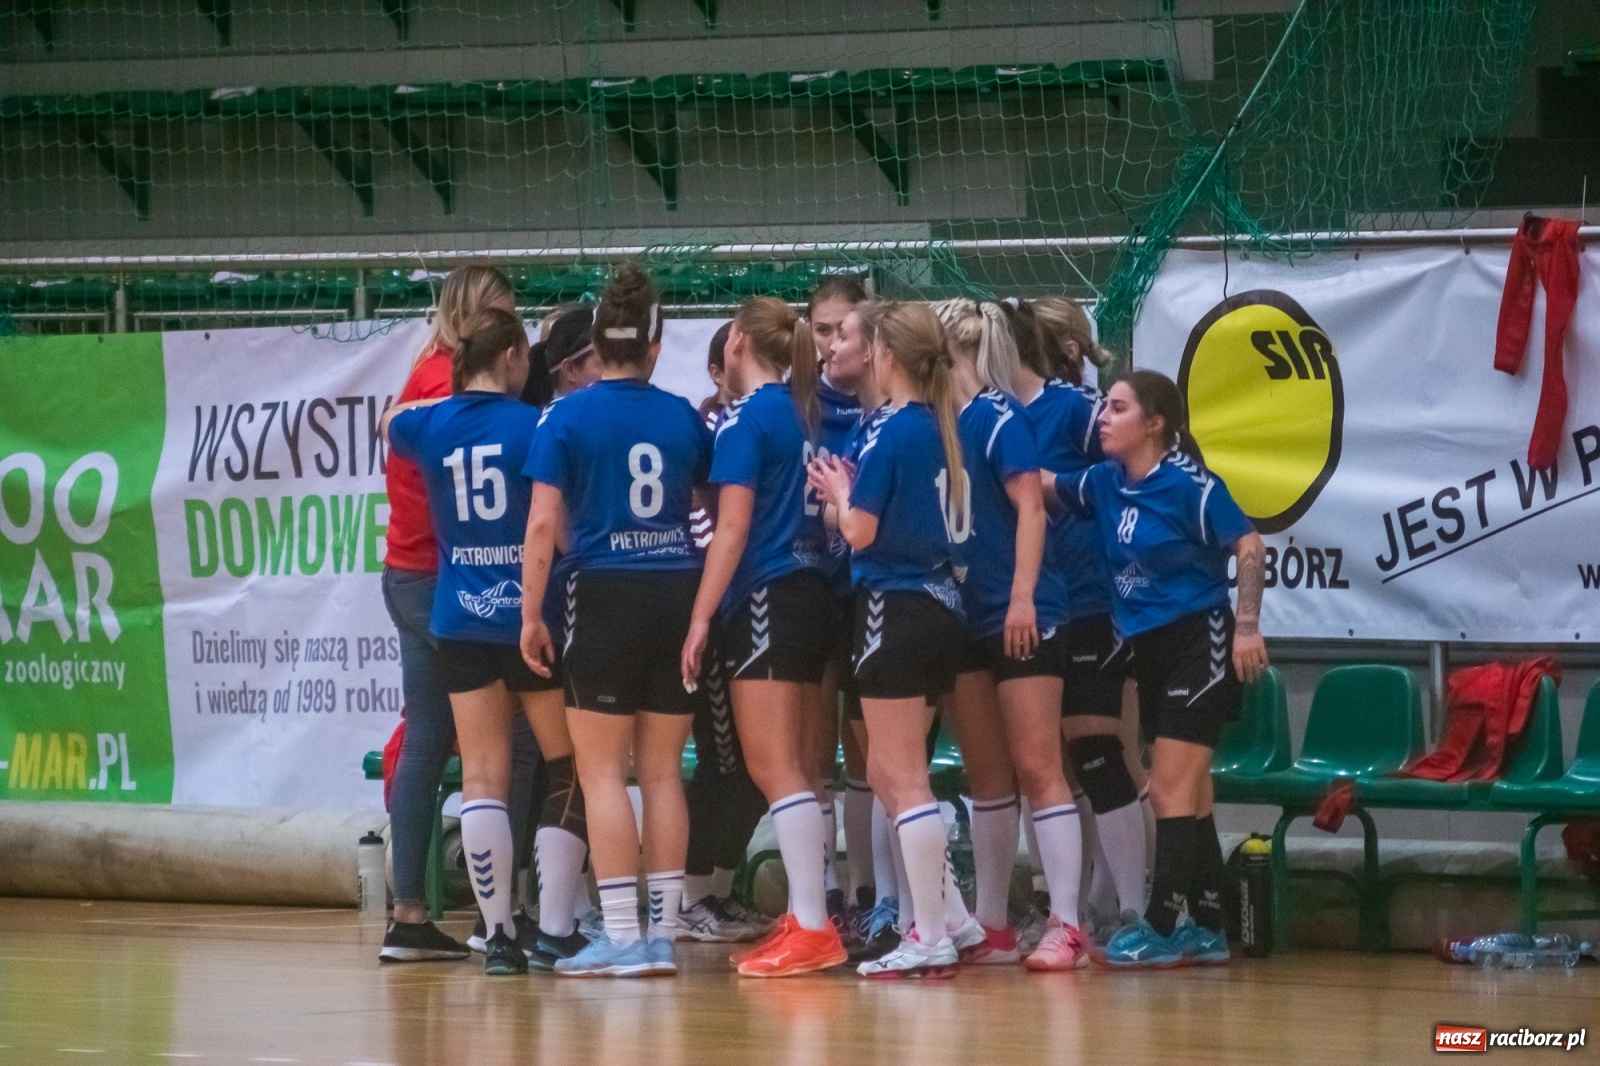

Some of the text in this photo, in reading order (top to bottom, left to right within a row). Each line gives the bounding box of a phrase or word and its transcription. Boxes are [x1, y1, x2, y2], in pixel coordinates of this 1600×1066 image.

[443, 443, 507, 521] 15
[628, 442, 664, 518] 8
[1375, 468, 1496, 572] JEST
[1509, 457, 1558, 512] W
[184, 492, 388, 578] DOMOWE
[1117, 507, 1139, 544] 18
[0, 548, 122, 645] AR
[5, 652, 125, 691] zoologiczny
[192, 630, 402, 672] Dzielimy się naszą pas
[195, 678, 400, 723] i wiedzą od 1989 roku
